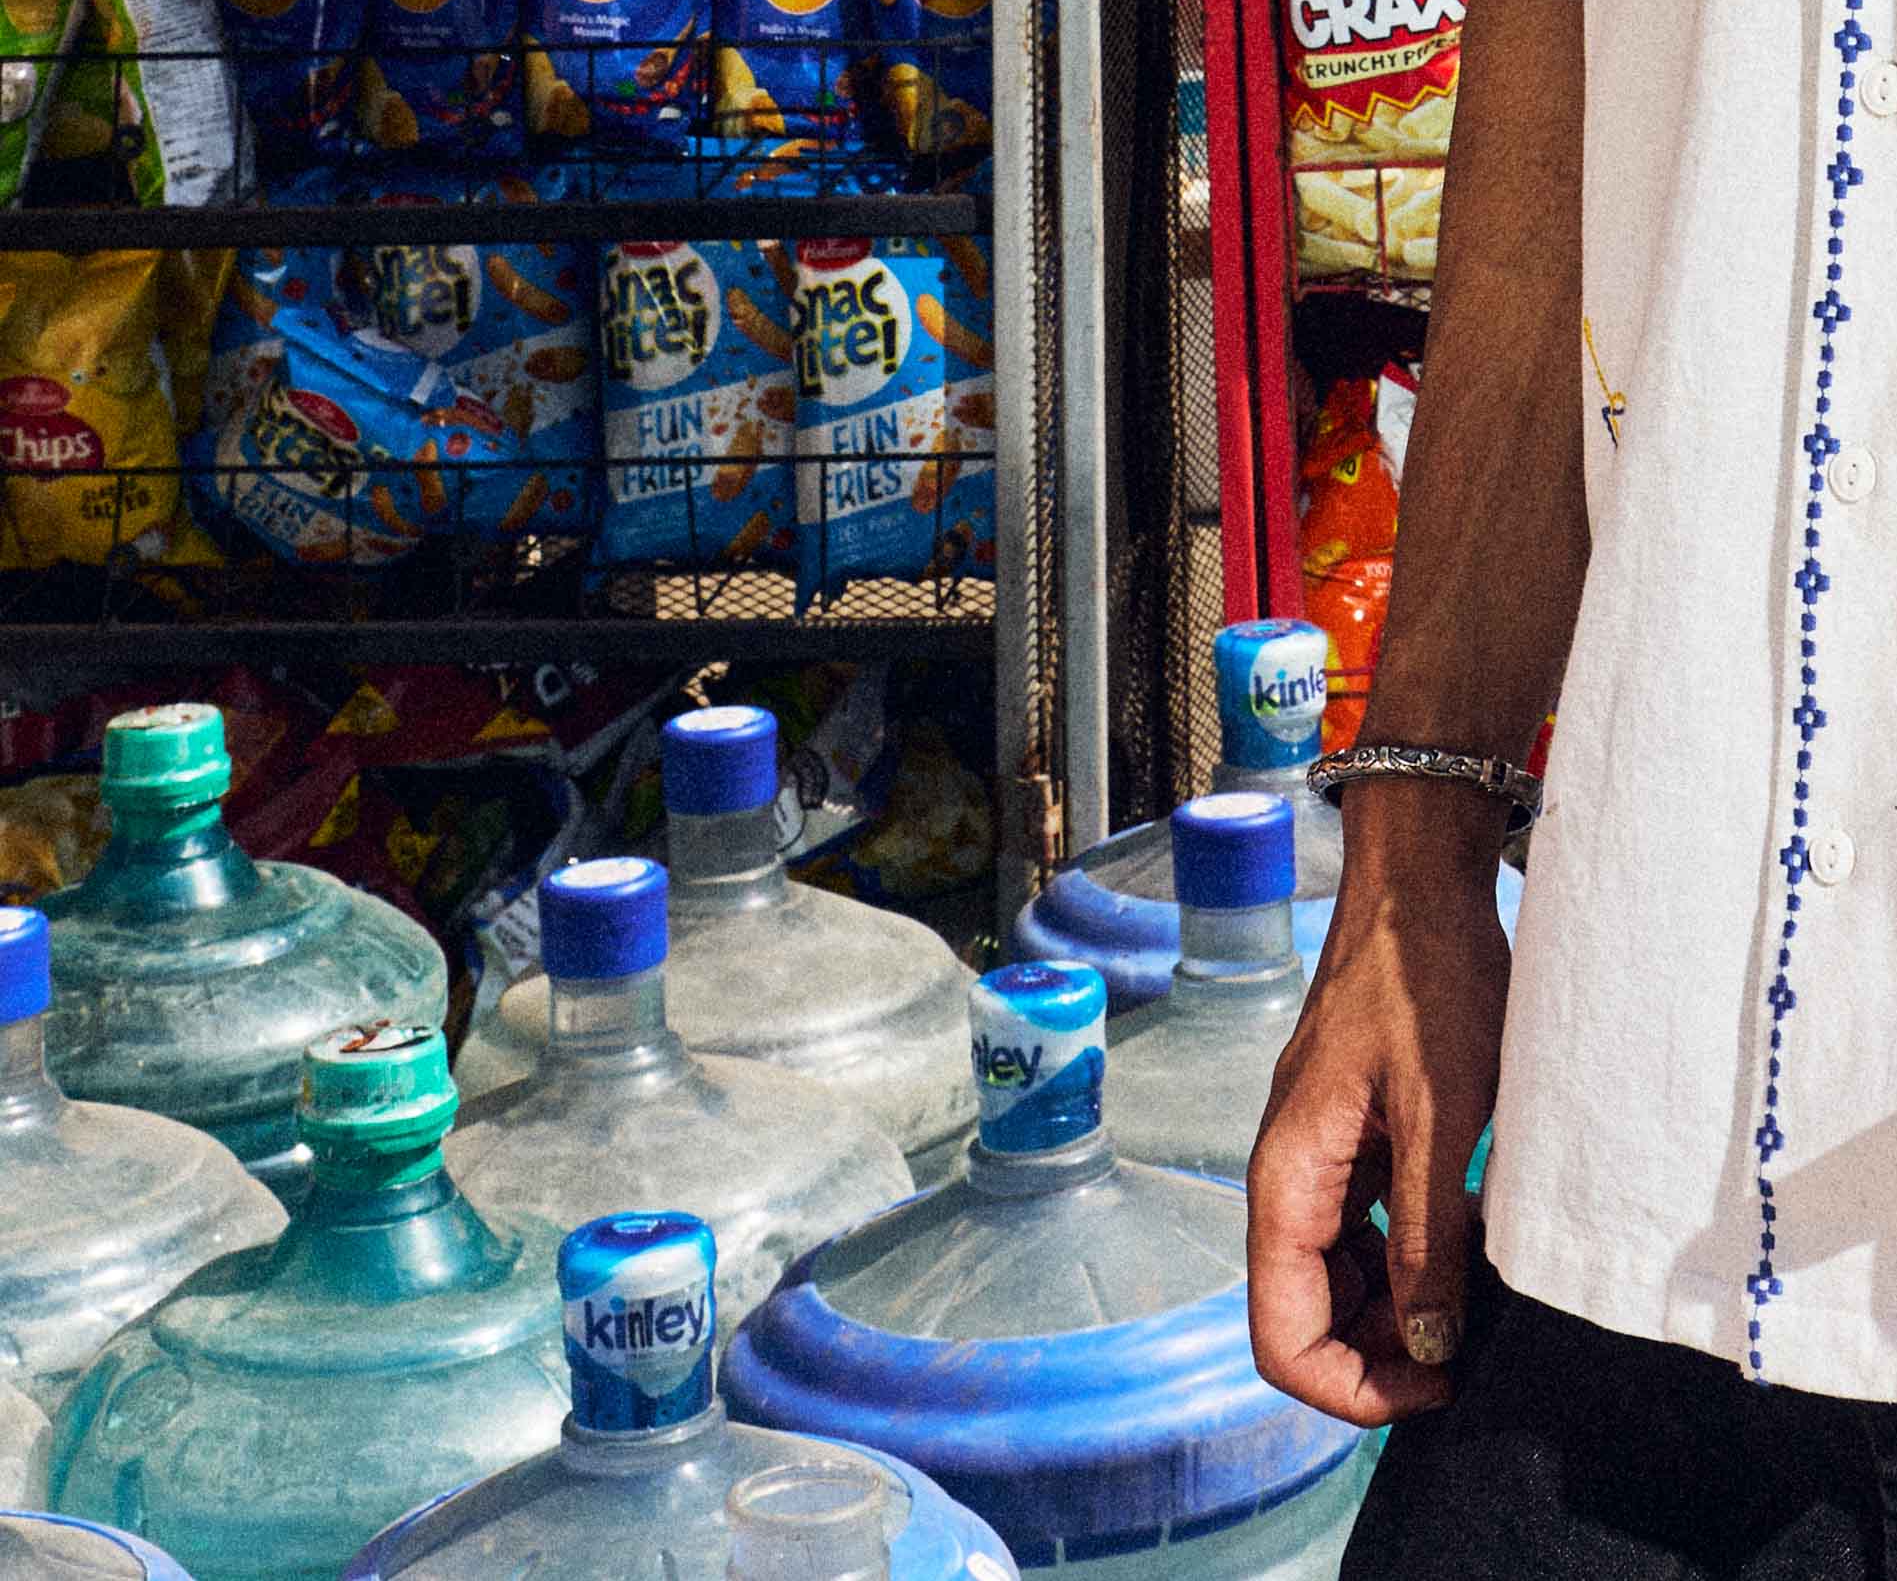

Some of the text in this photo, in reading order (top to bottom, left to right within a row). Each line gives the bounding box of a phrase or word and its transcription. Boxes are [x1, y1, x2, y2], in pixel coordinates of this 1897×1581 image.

[1305, 53, 1398, 80] CRUNCHY
[637, 401, 703, 447] FUN
[831, 408, 900, 456] FUN
[583, 1292, 706, 1351] kinley
